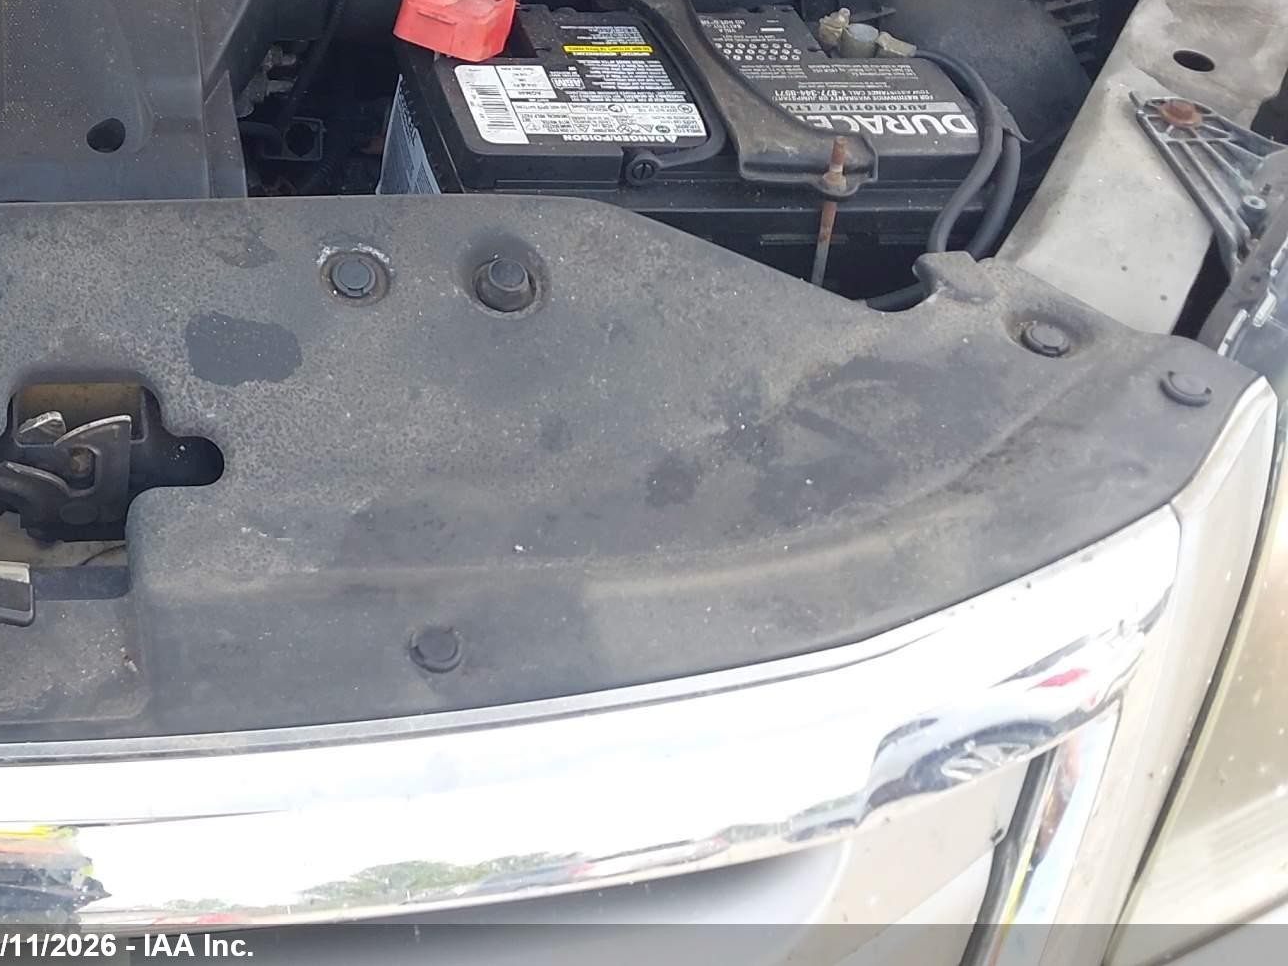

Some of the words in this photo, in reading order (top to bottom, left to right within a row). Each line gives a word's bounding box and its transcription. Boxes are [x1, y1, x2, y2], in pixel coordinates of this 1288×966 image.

[829, 103, 928, 112] AUTOMOTIVE
[795, 114, 978, 135] DURACE
[562, 134, 666, 142] DANGER/POISON
